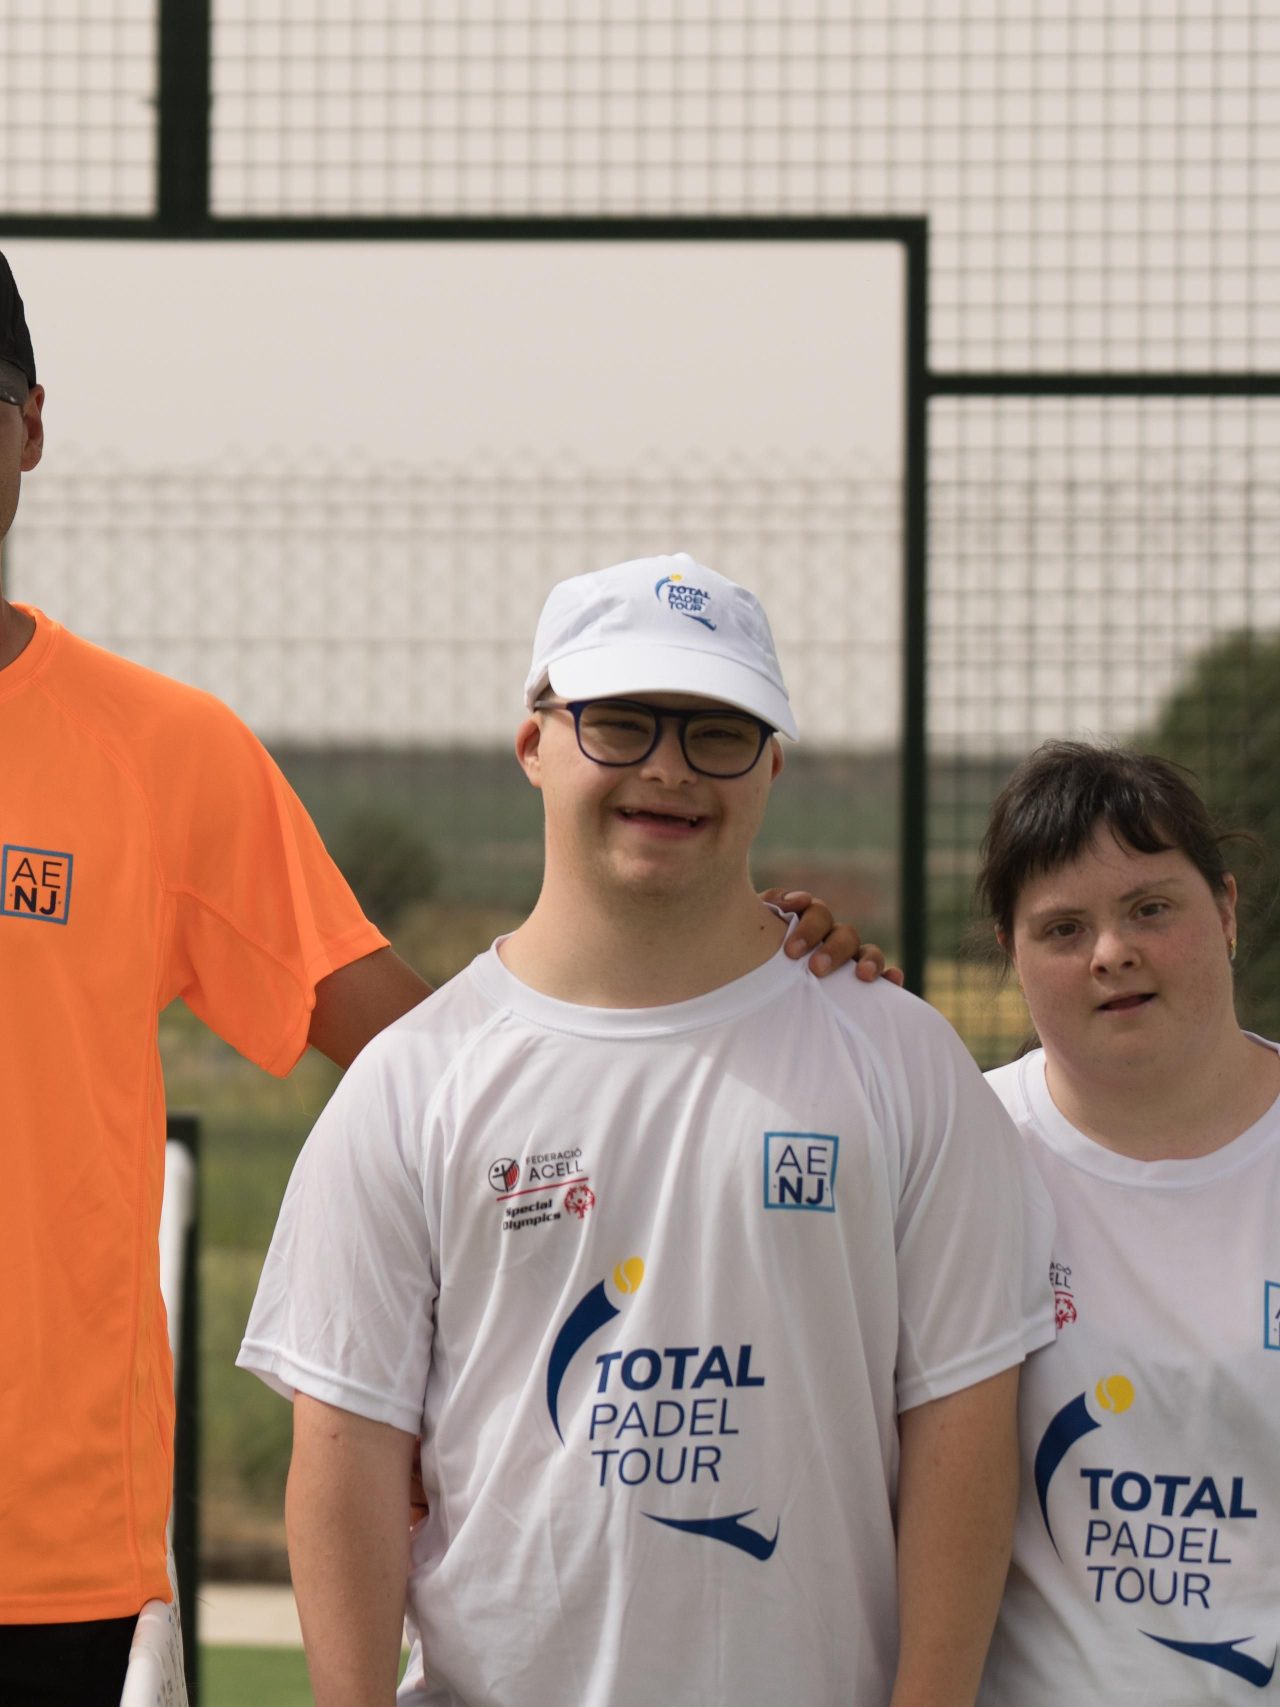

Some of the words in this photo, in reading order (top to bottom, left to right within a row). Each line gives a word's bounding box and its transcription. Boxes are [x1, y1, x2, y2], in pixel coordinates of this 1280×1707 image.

[667, 585, 711, 600] TOTAL
[668, 593, 706, 606] PADEL
[12, 857, 63, 889] AE
[525, 1148, 582, 1165] FEDERACIÓ
[529, 1160, 583, 1182] ACELL
[774, 1144, 828, 1176] AE
[503, 1212, 561, 1230] Olympics
[506, 1199, 552, 1218] Special
[595, 1345, 765, 1394] TOTAL
[588, 1398, 739, 1441] PADEL
[592, 1445, 722, 1487] TOUR
[1080, 1467, 1258, 1519] TOTAL
[1084, 1519, 1231, 1564] PADEL
[1086, 1565, 1210, 1609] TOUR
